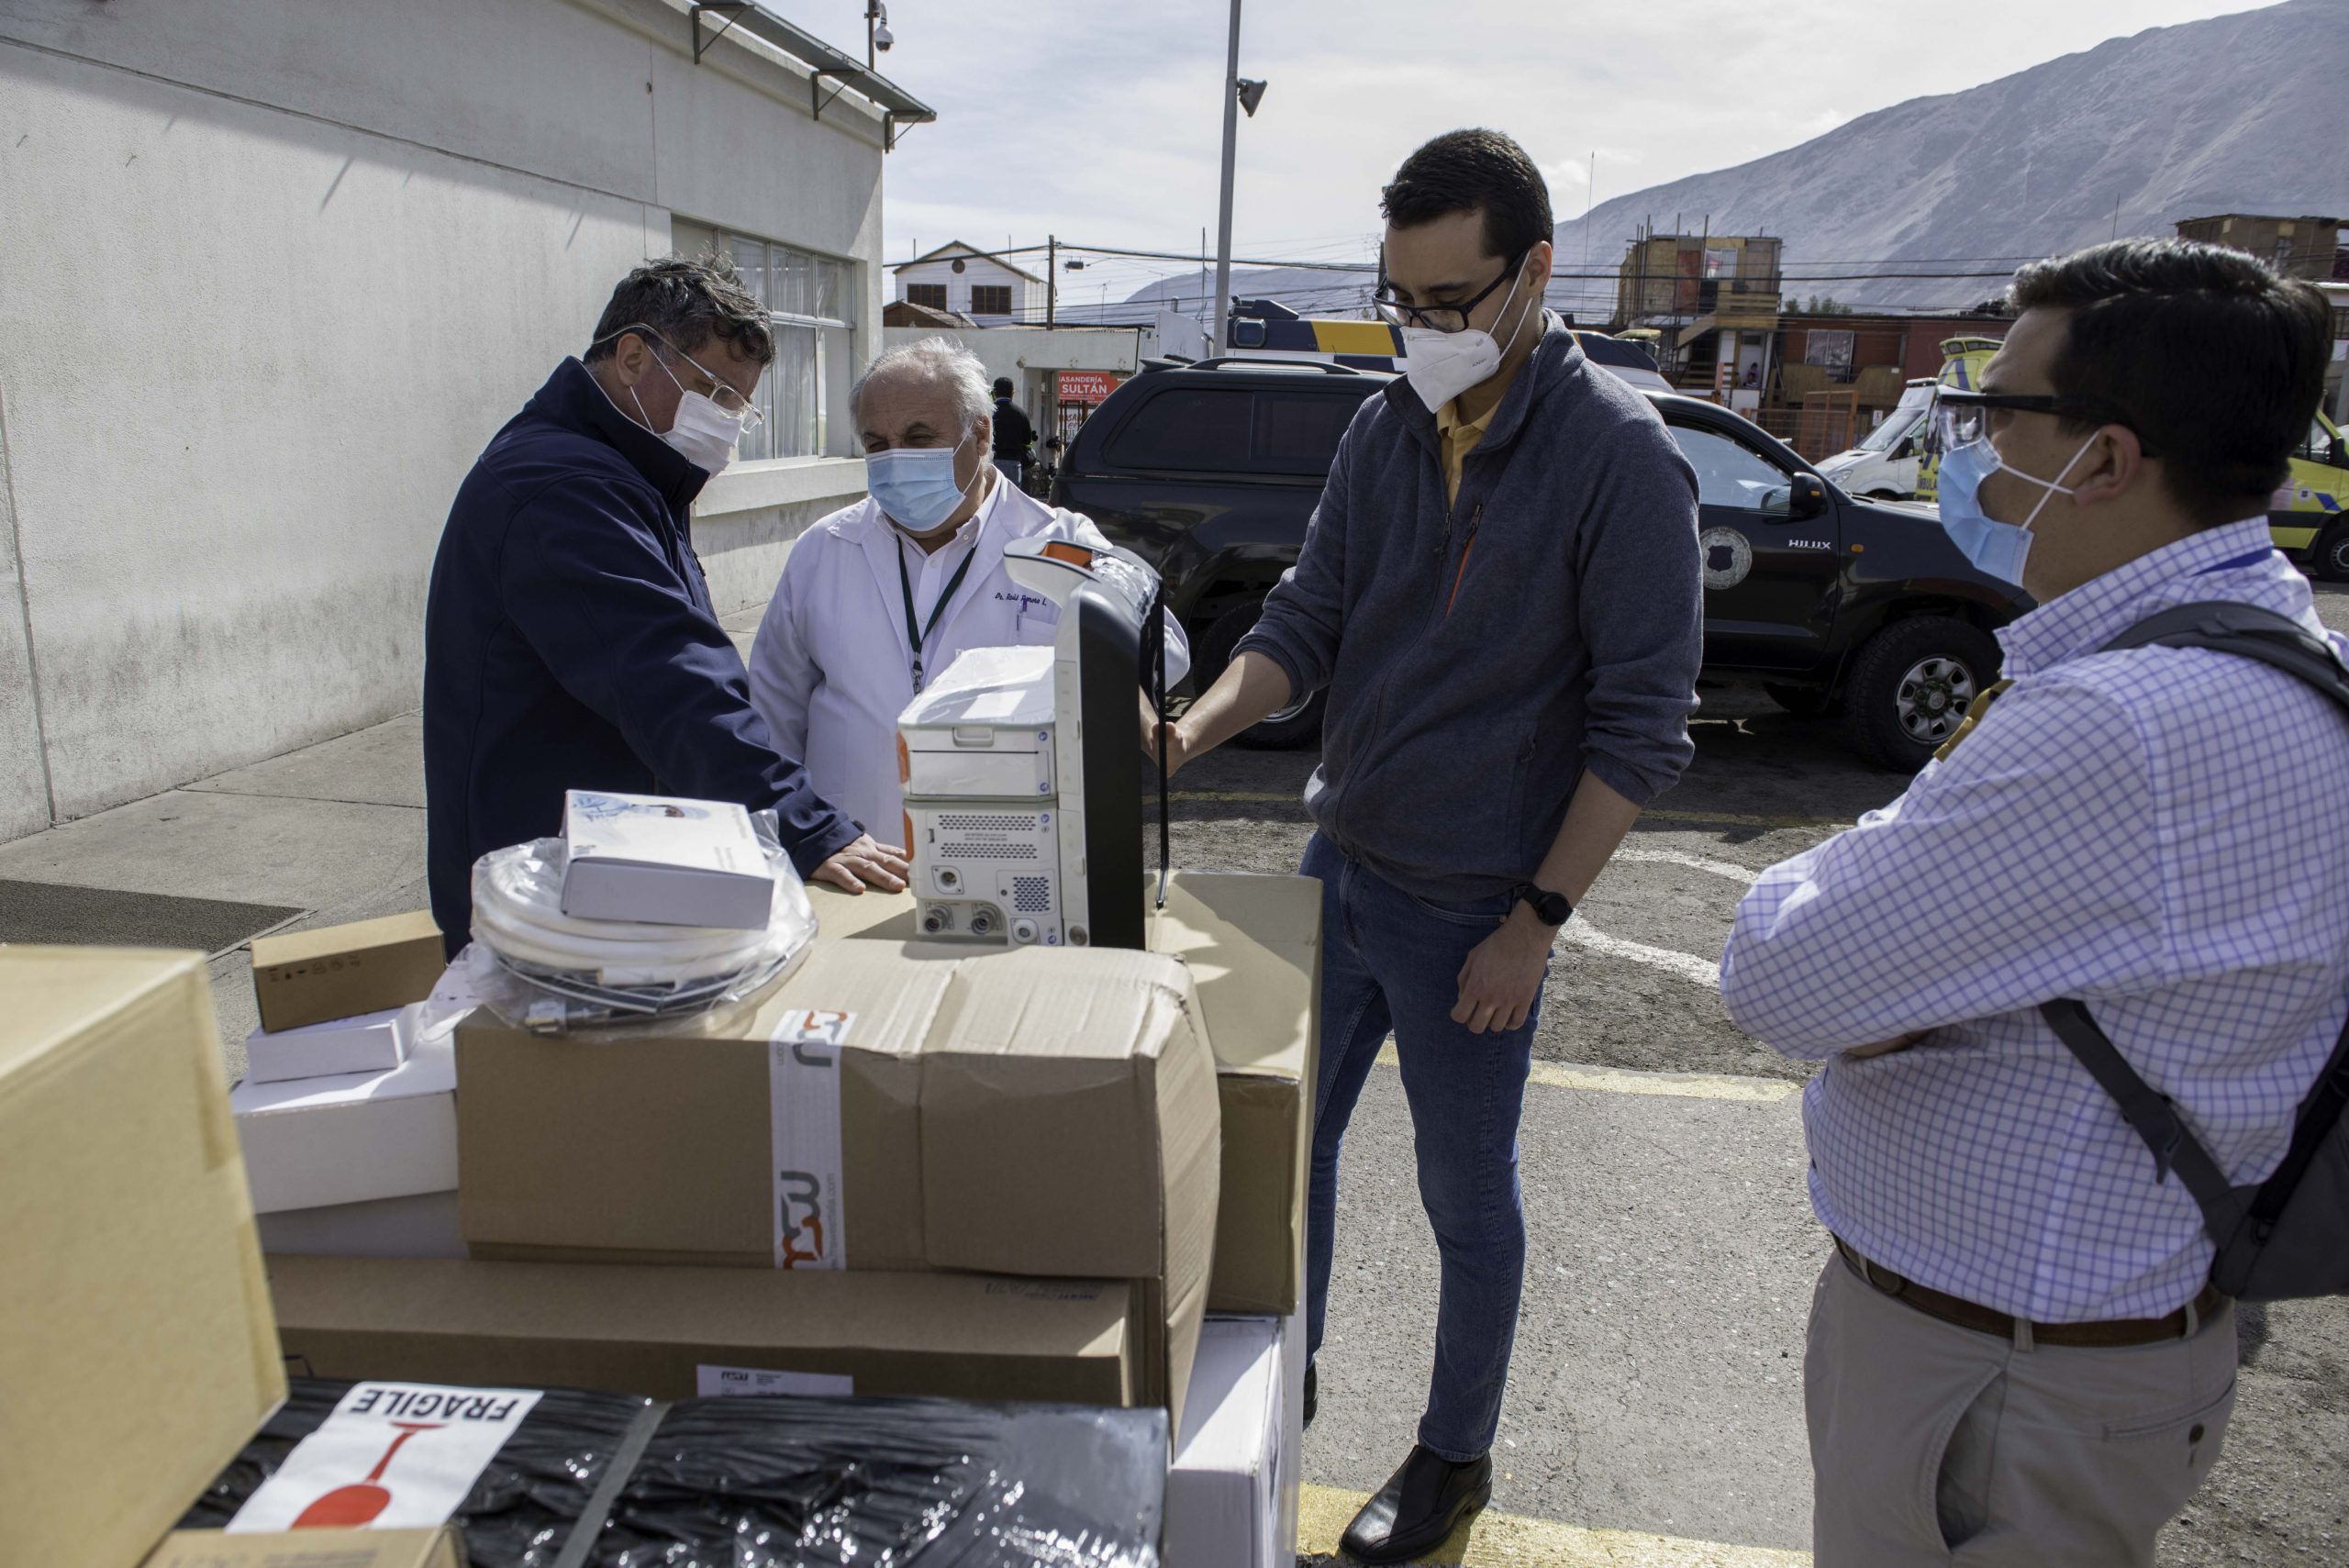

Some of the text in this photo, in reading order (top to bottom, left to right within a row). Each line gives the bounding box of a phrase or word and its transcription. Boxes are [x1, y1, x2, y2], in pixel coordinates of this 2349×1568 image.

[1058, 375, 1103, 384] ASANDERÍA
[1062, 382, 1108, 395] SULTÁN
[1788, 539, 1831, 550] HILUX
[349, 1388, 519, 1421] FRAGILE
